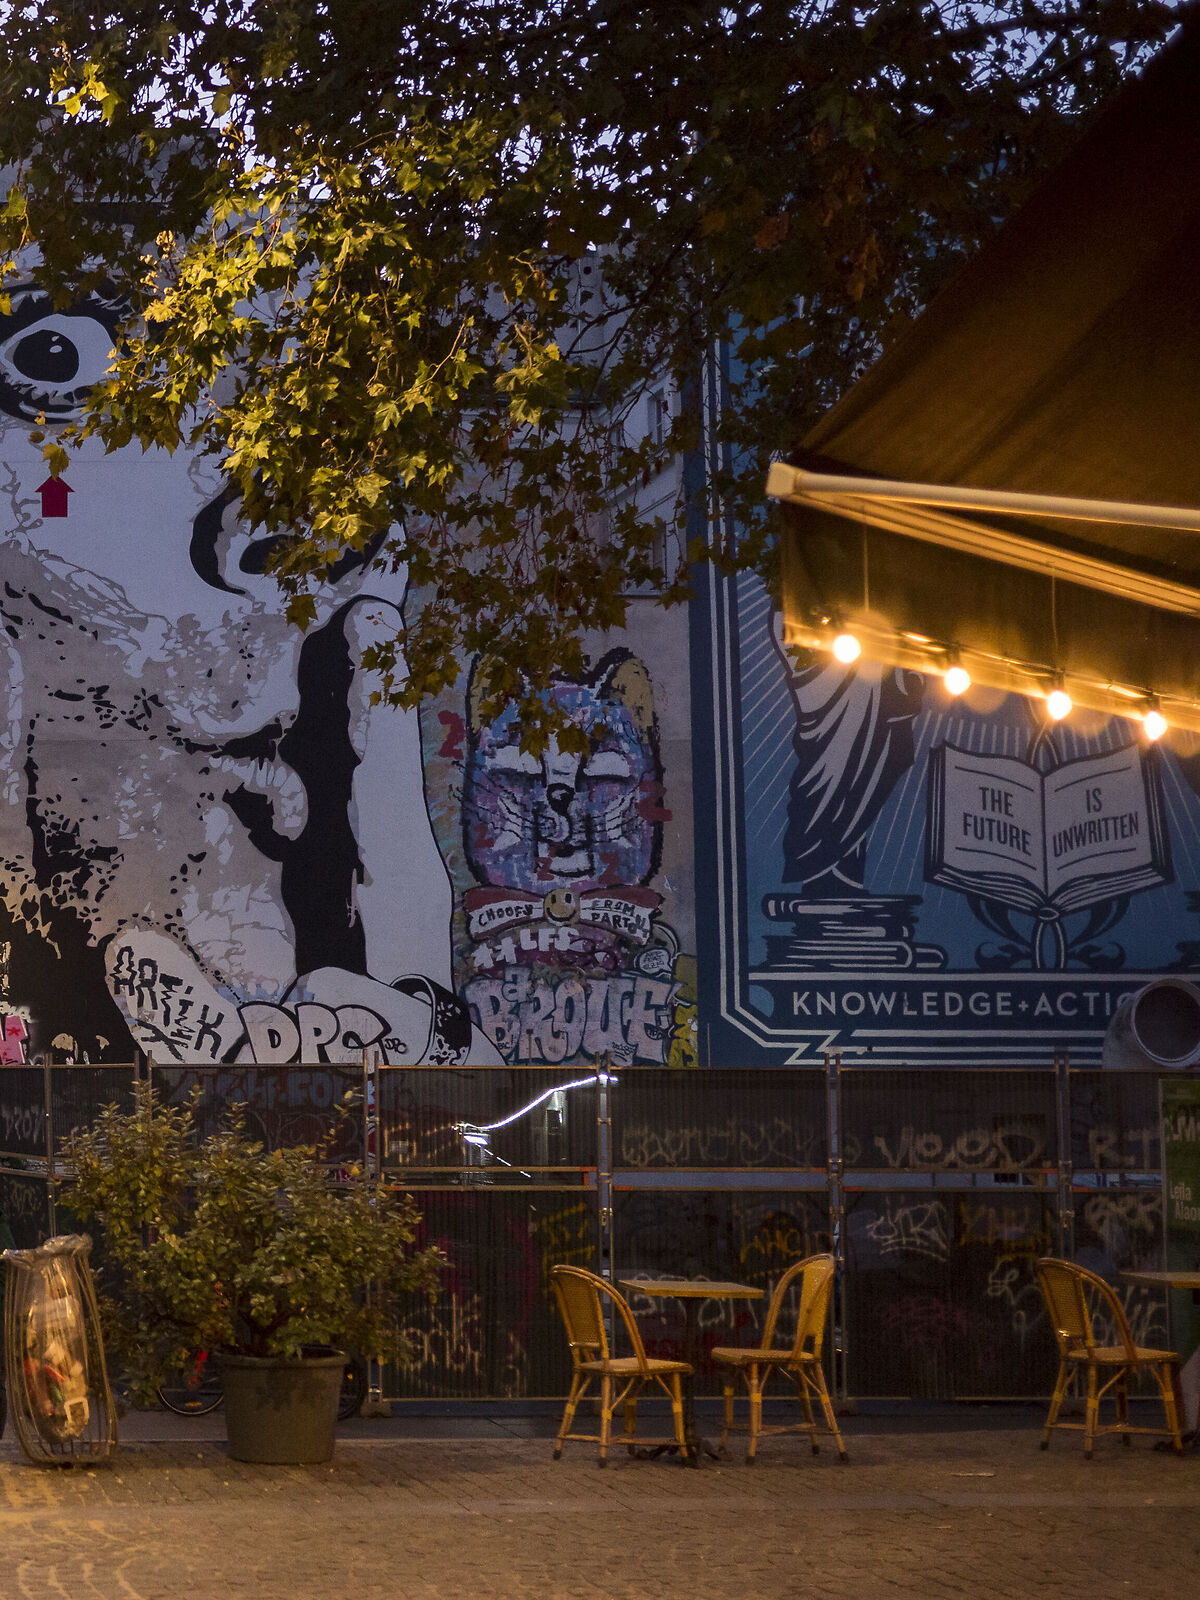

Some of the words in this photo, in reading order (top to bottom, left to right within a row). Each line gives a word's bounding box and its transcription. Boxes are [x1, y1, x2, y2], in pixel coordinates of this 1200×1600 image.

[979, 787, 1014, 817] THE
[1086, 788, 1102, 813] IS
[963, 812, 1031, 856] FUTURE
[1053, 812, 1139, 857] UNWRITTEN
